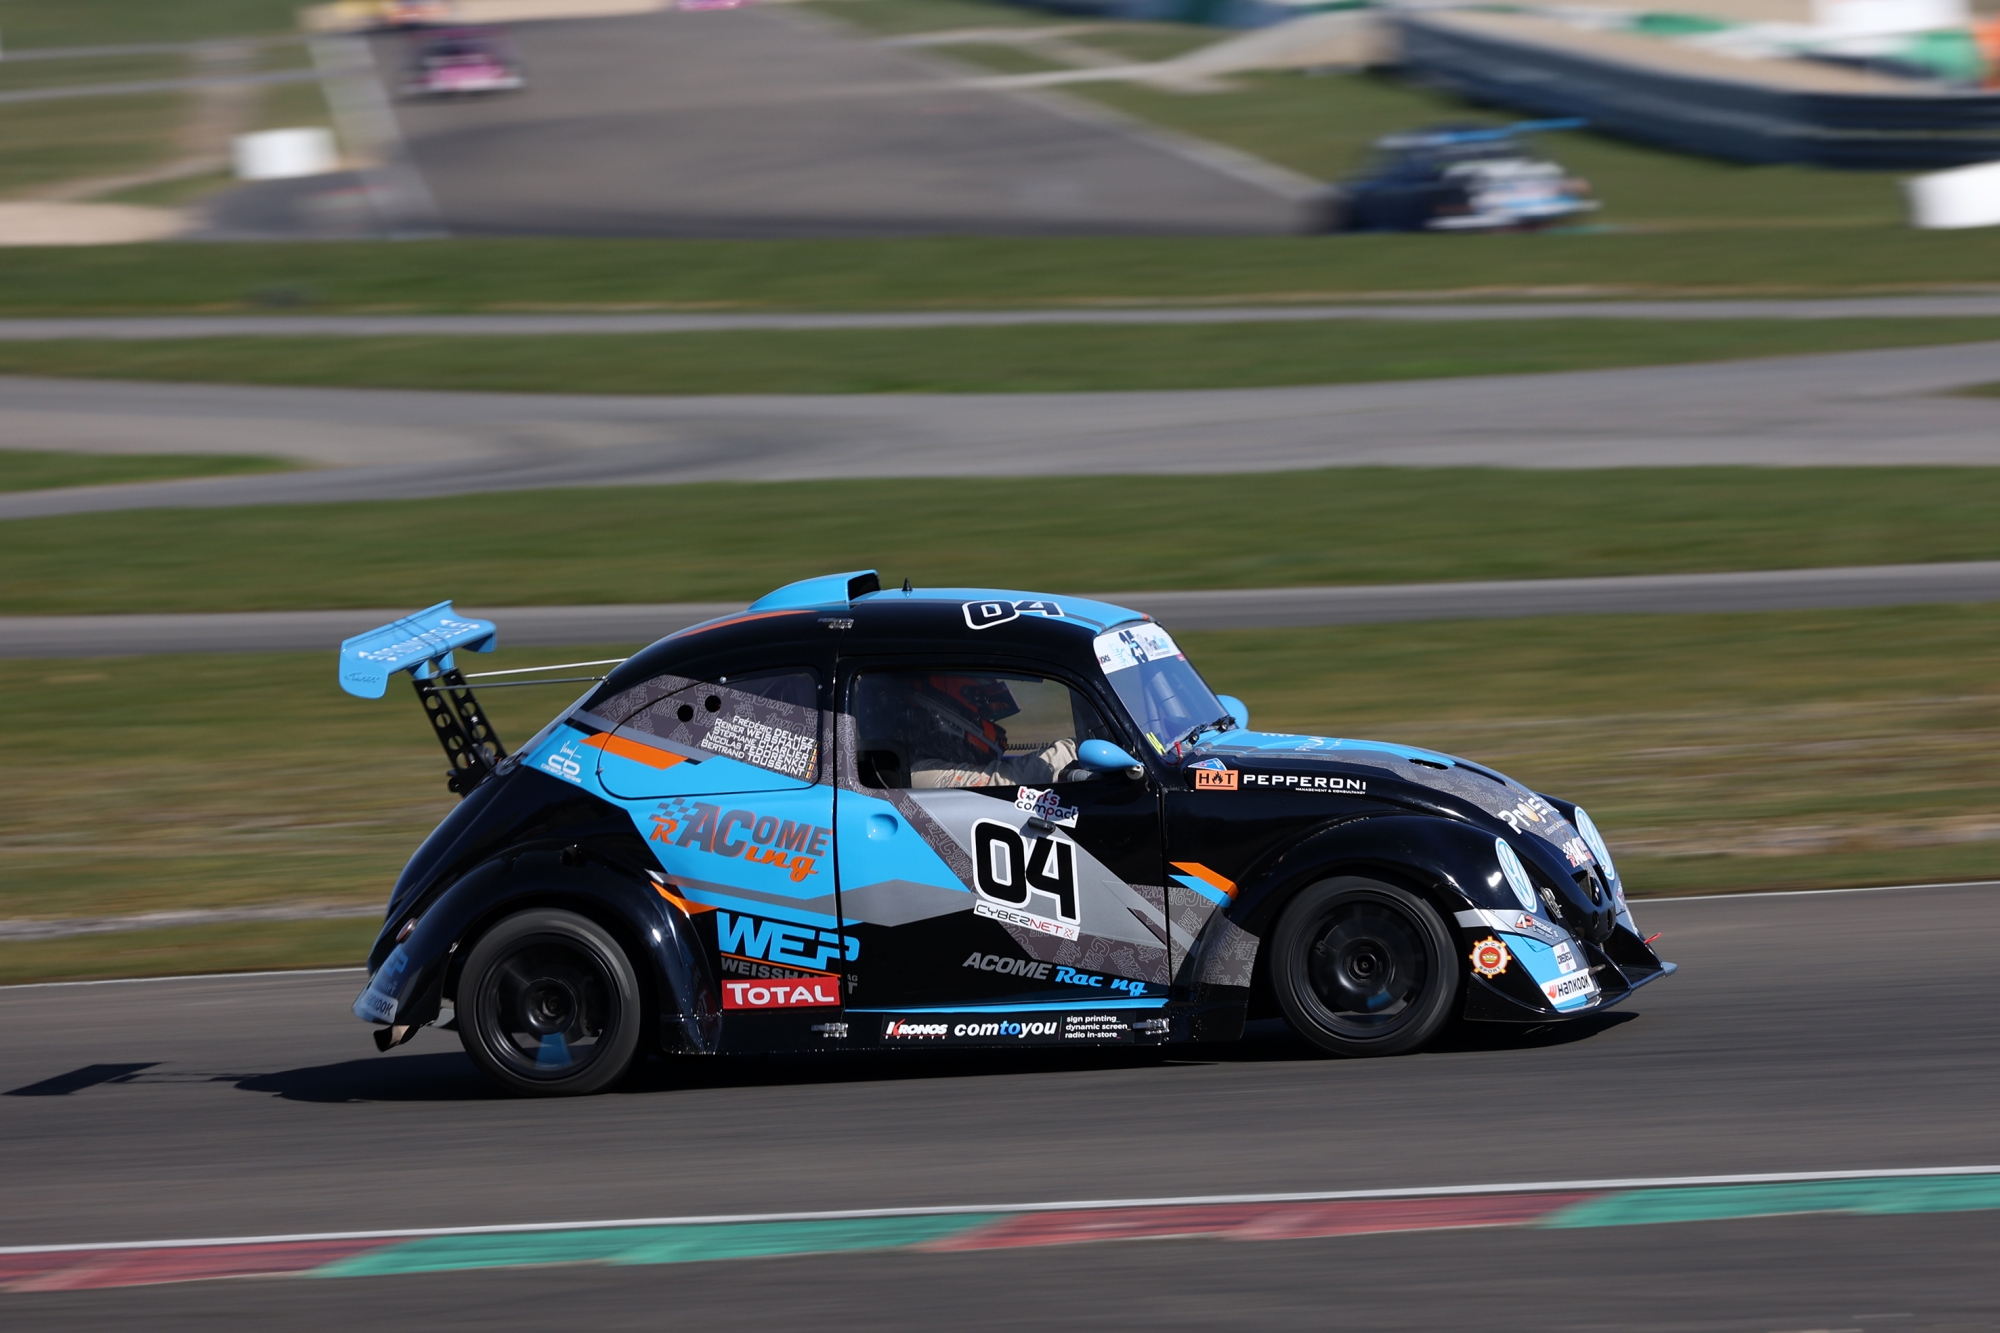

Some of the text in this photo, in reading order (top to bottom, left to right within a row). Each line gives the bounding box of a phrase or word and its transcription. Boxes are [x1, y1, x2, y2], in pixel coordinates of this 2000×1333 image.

[962, 600, 1065, 630] 04
[714, 719, 745, 734] REINER
[746, 727, 813, 754] WEISSHAUPT
[774, 728, 815, 747] DELHEZ
[700, 738, 806, 776] BERTRAND TOUSSAINT
[705, 732, 806, 769] NICOLAS FEDORENKO
[757, 740, 810, 762] CHARLIER
[1243, 774, 1367, 791] PEPPERONI
[1016, 799, 1079, 820] compact
[972, 819, 1080, 924] 04
[716, 910, 860, 971] WEP
[963, 952, 1052, 980] ACOME
[726, 982, 835, 1006] TOTAL
[886, 1019, 1057, 1039] KRONOS comtoyou
[1065, 1023, 1099, 1032] dynamic
[1066, 1015, 1084, 1024] sign
[1065, 1031, 1085, 1039] radio
